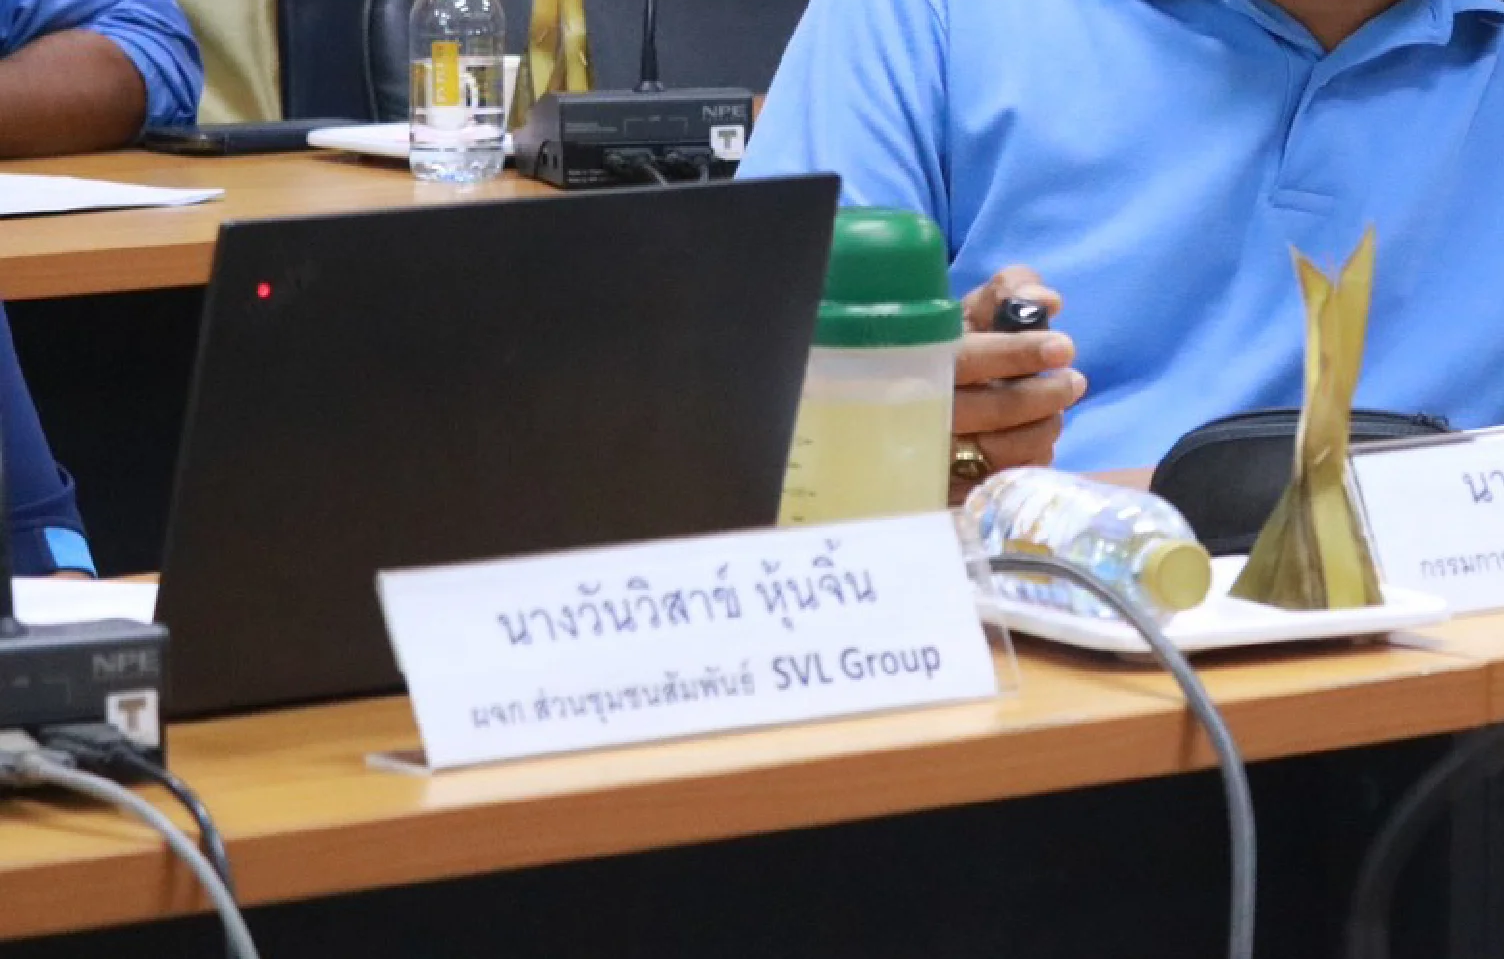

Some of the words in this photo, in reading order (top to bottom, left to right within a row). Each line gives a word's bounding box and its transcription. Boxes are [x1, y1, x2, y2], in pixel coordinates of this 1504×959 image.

[702, 105, 747, 119] NPE
[496, 561, 742, 647] นางวันวิสาข์
[754, 537, 878, 631] หุ้นจิ้น
[772, 651, 836, 693] SVL
[839, 641, 943, 686] Group
